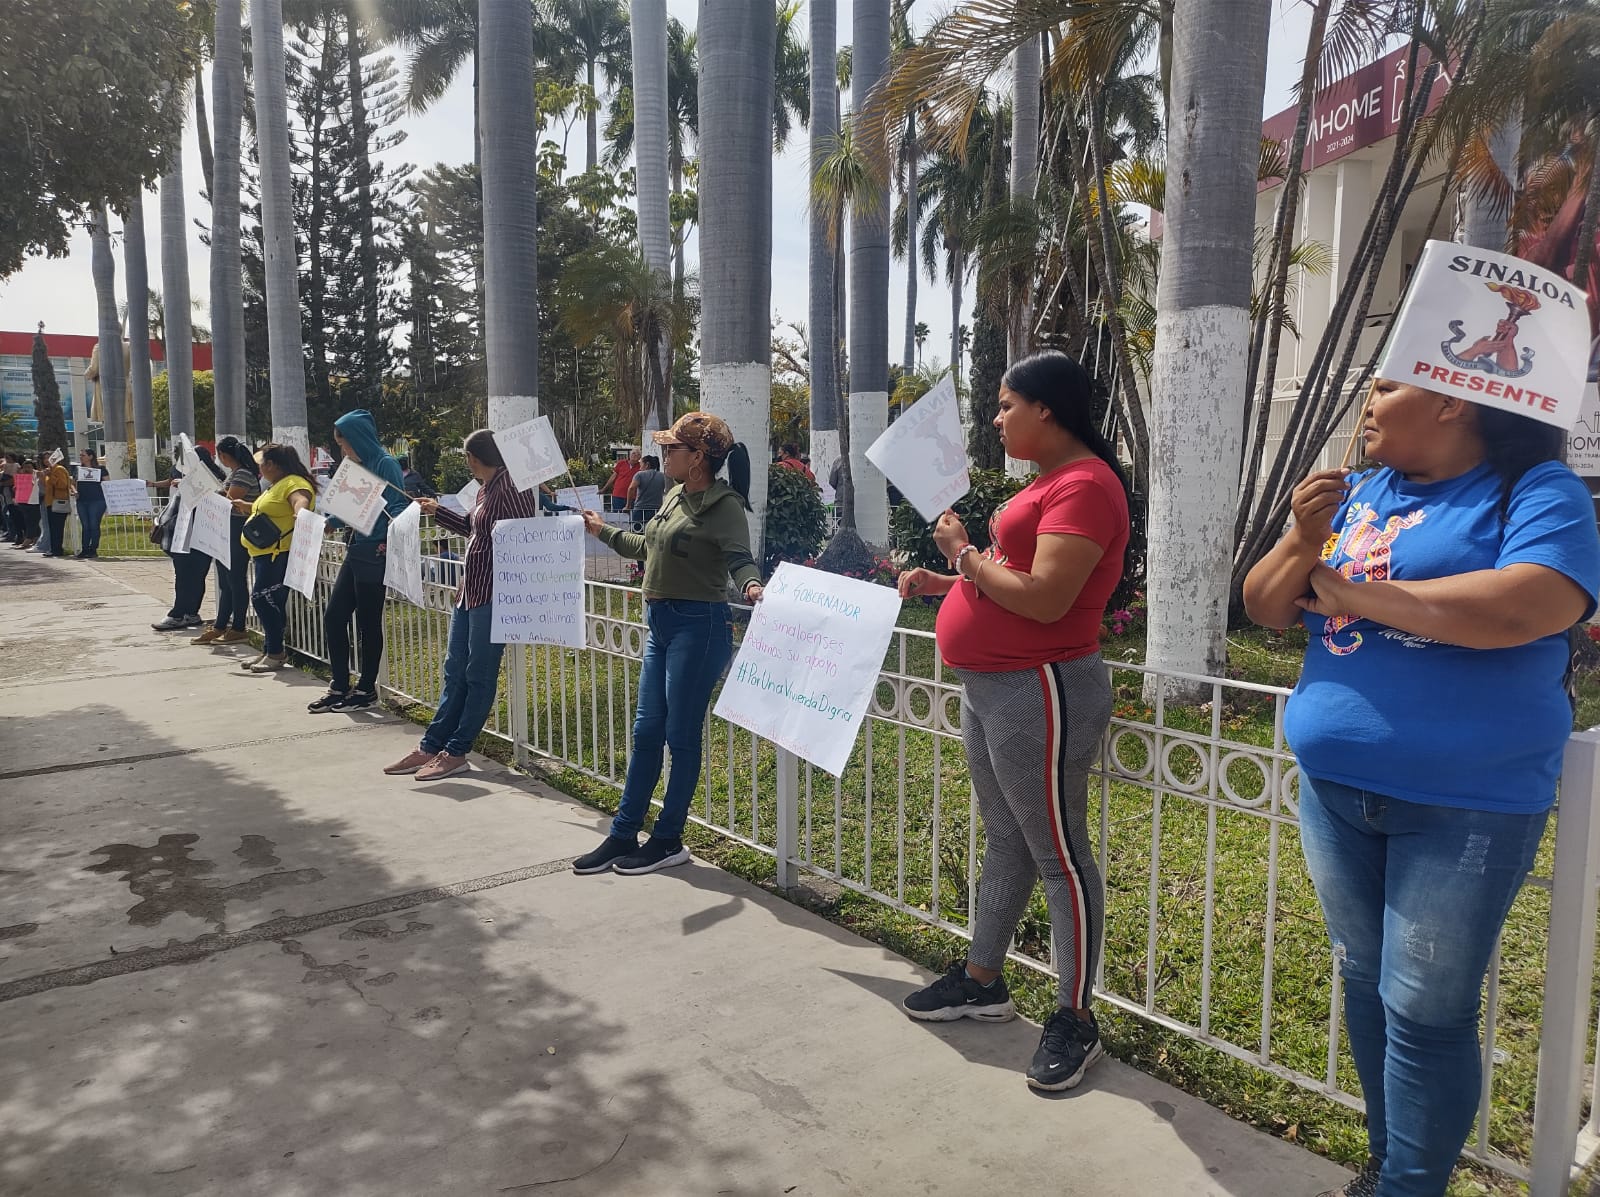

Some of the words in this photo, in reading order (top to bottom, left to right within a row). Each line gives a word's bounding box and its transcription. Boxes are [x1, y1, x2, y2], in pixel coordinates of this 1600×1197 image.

[1306, 86, 1382, 146] AHOME
[1447, 255, 1576, 311] SINALOA
[1413, 361, 1559, 414] PRESENTE
